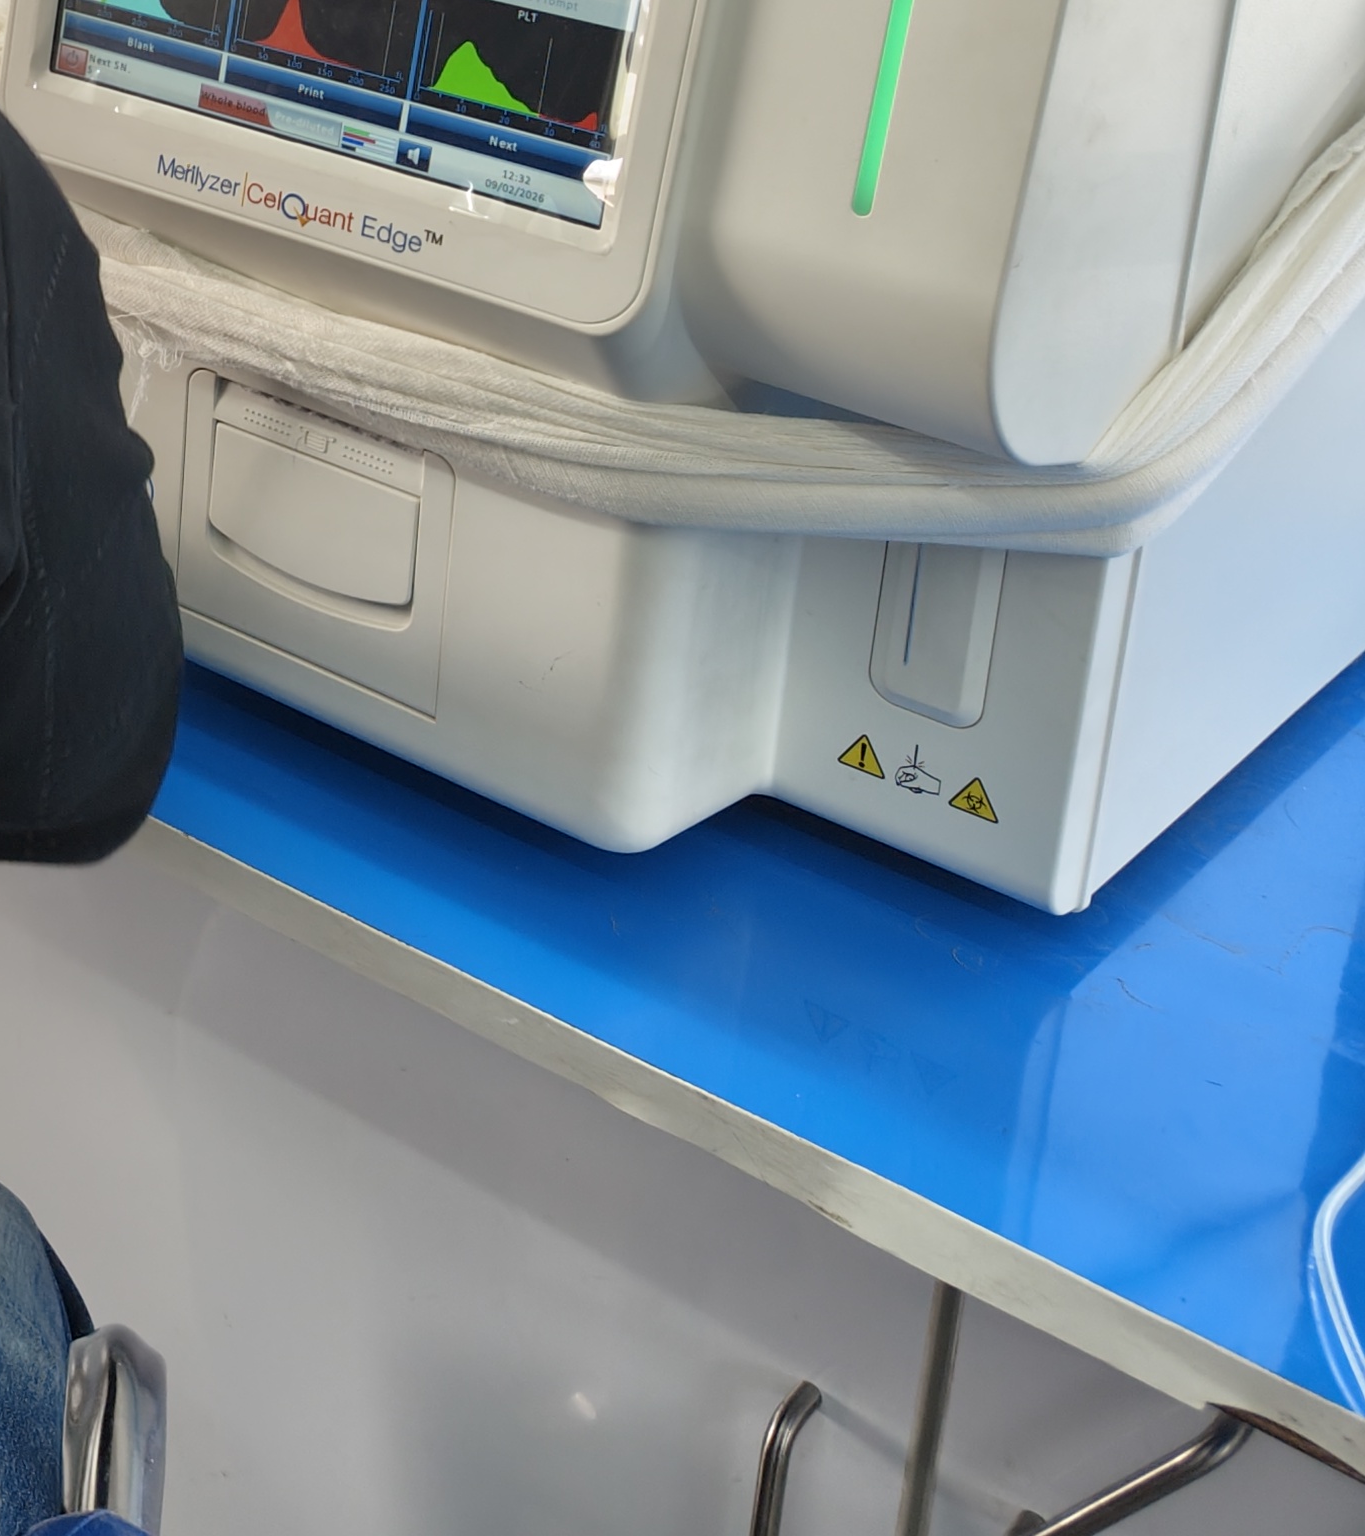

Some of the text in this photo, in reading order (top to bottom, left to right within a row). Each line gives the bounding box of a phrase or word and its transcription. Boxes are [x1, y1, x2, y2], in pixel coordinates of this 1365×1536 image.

[518, 9, 539, 24] PLT
[127, 36, 156, 53] Blank
[297, 83, 325, 101] Print
[201, 90, 266, 116] Whole blood
[489, 135, 518, 153] Next
[502, 169, 532, 186] 12:32
[157, 154, 241, 198] Merilyzer
[246, 182, 356, 234] CelQuant
[485, 178, 546, 204] 09/02/2026
